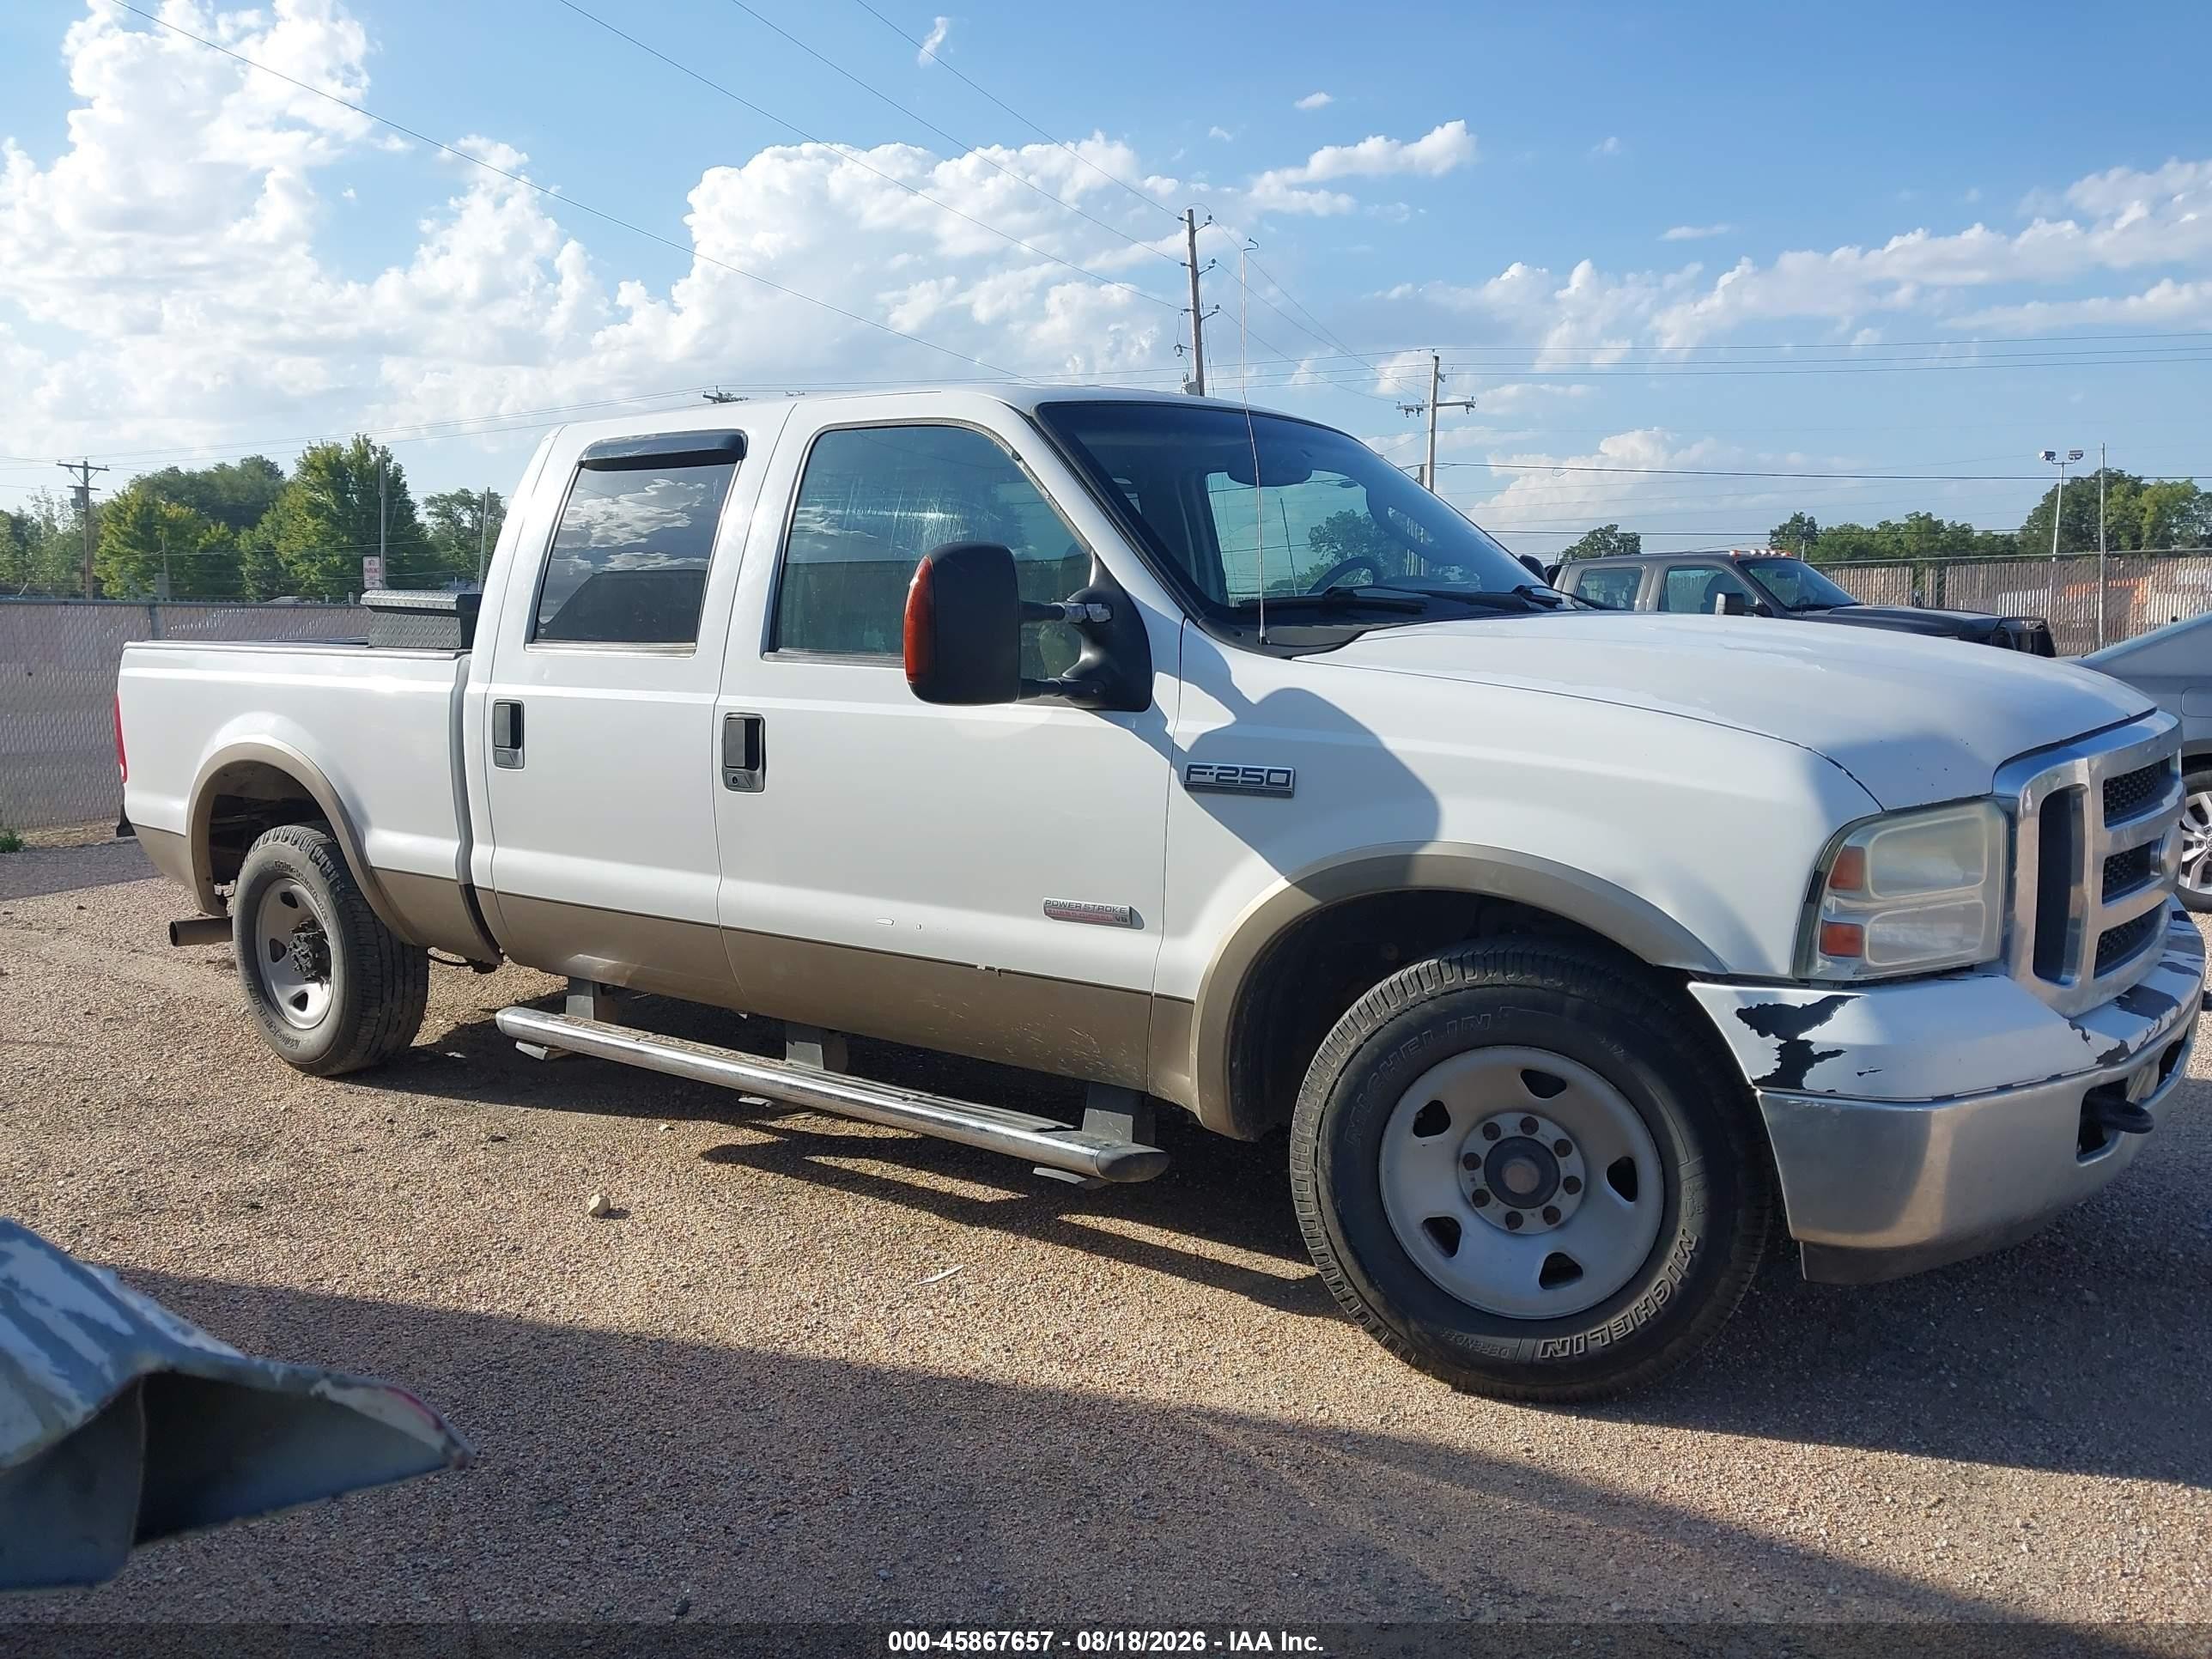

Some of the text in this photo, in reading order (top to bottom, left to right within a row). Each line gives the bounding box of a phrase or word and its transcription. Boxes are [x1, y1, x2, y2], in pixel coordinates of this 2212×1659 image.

[1186, 764, 1291, 787] F-250
[1045, 899, 1127, 915] POWER STROKE
[1115, 915, 1128, 923] V8
[1344, 1013, 1492, 1146] MICHELIN
[1538, 1225, 1698, 1359] MICHELIN
